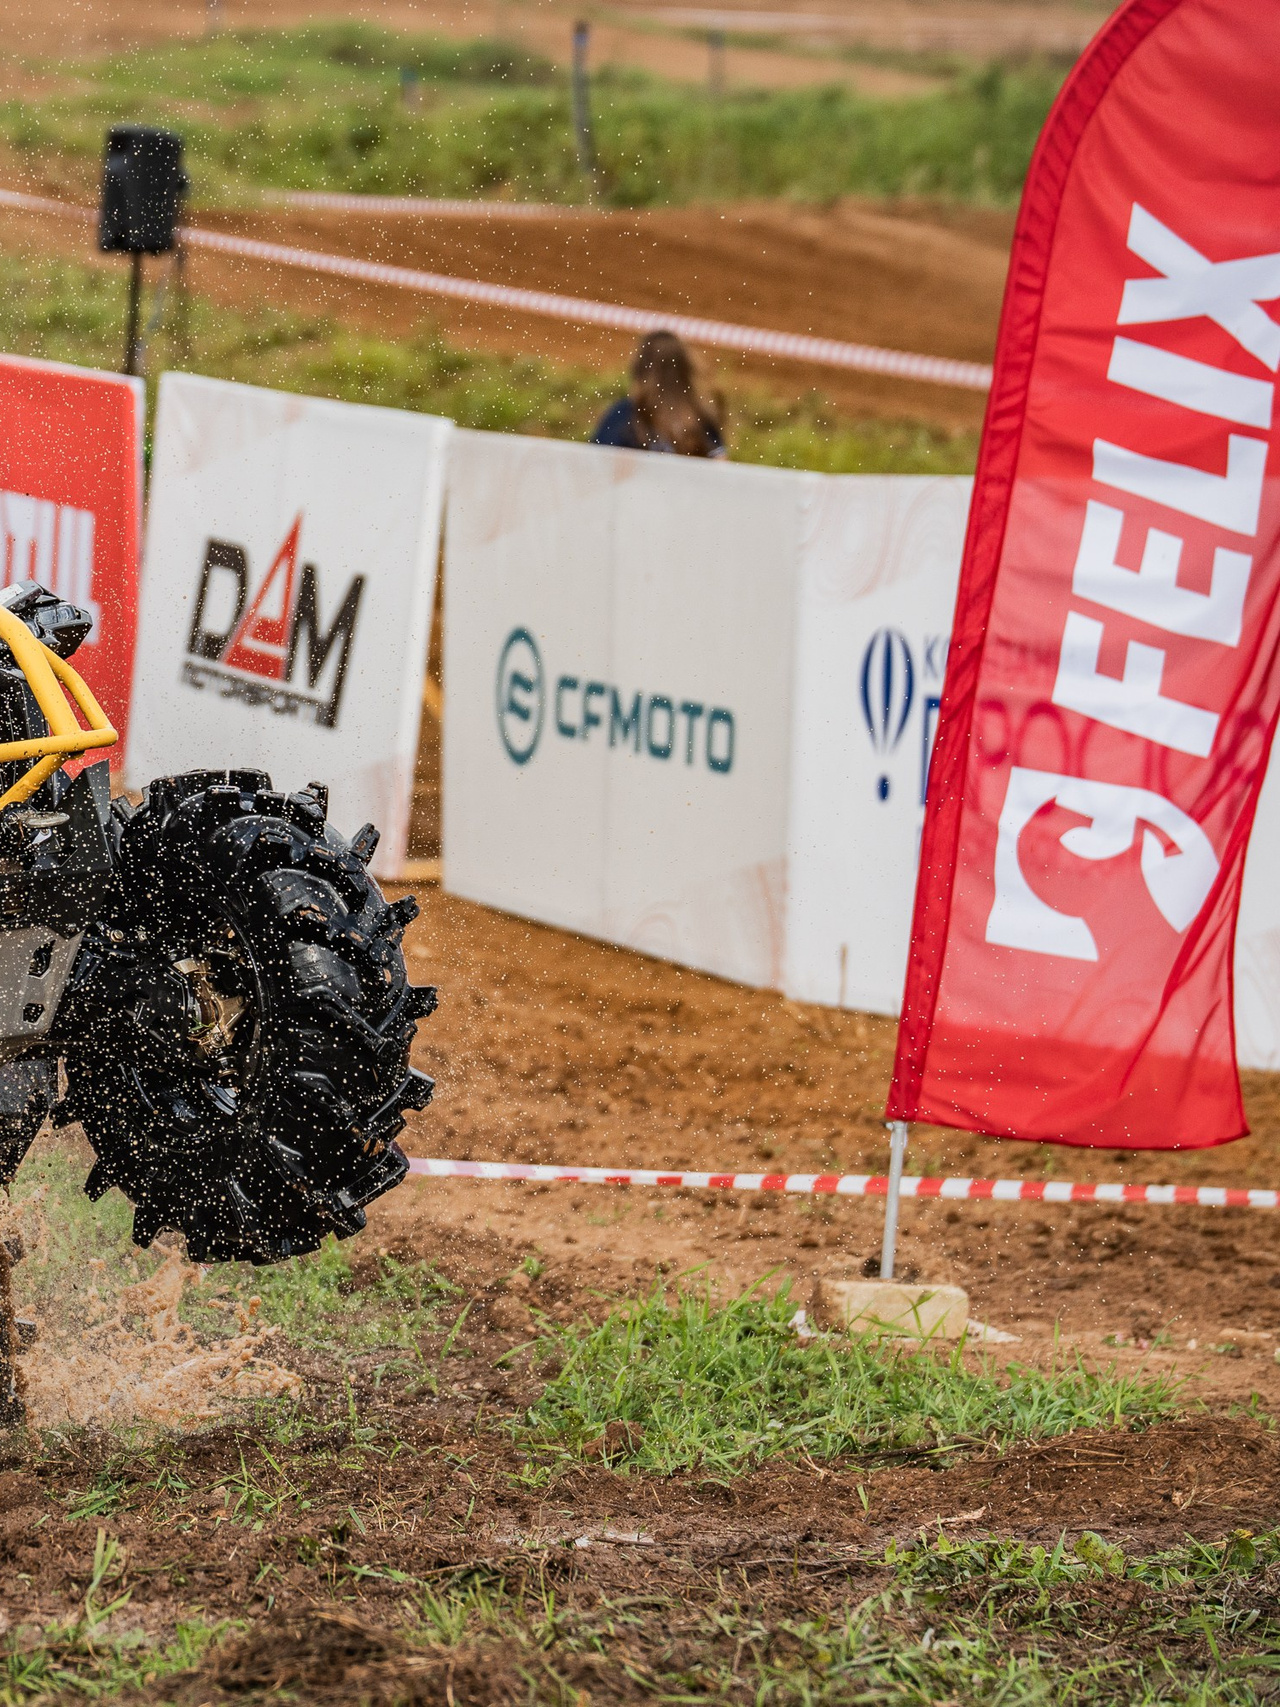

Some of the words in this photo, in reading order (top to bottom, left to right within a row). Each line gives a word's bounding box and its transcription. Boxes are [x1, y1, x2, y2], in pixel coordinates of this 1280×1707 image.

[1052, 201, 1280, 759] FELIX
[185, 509, 368, 729] DAM
[554, 673, 736, 774] CFMOTO
